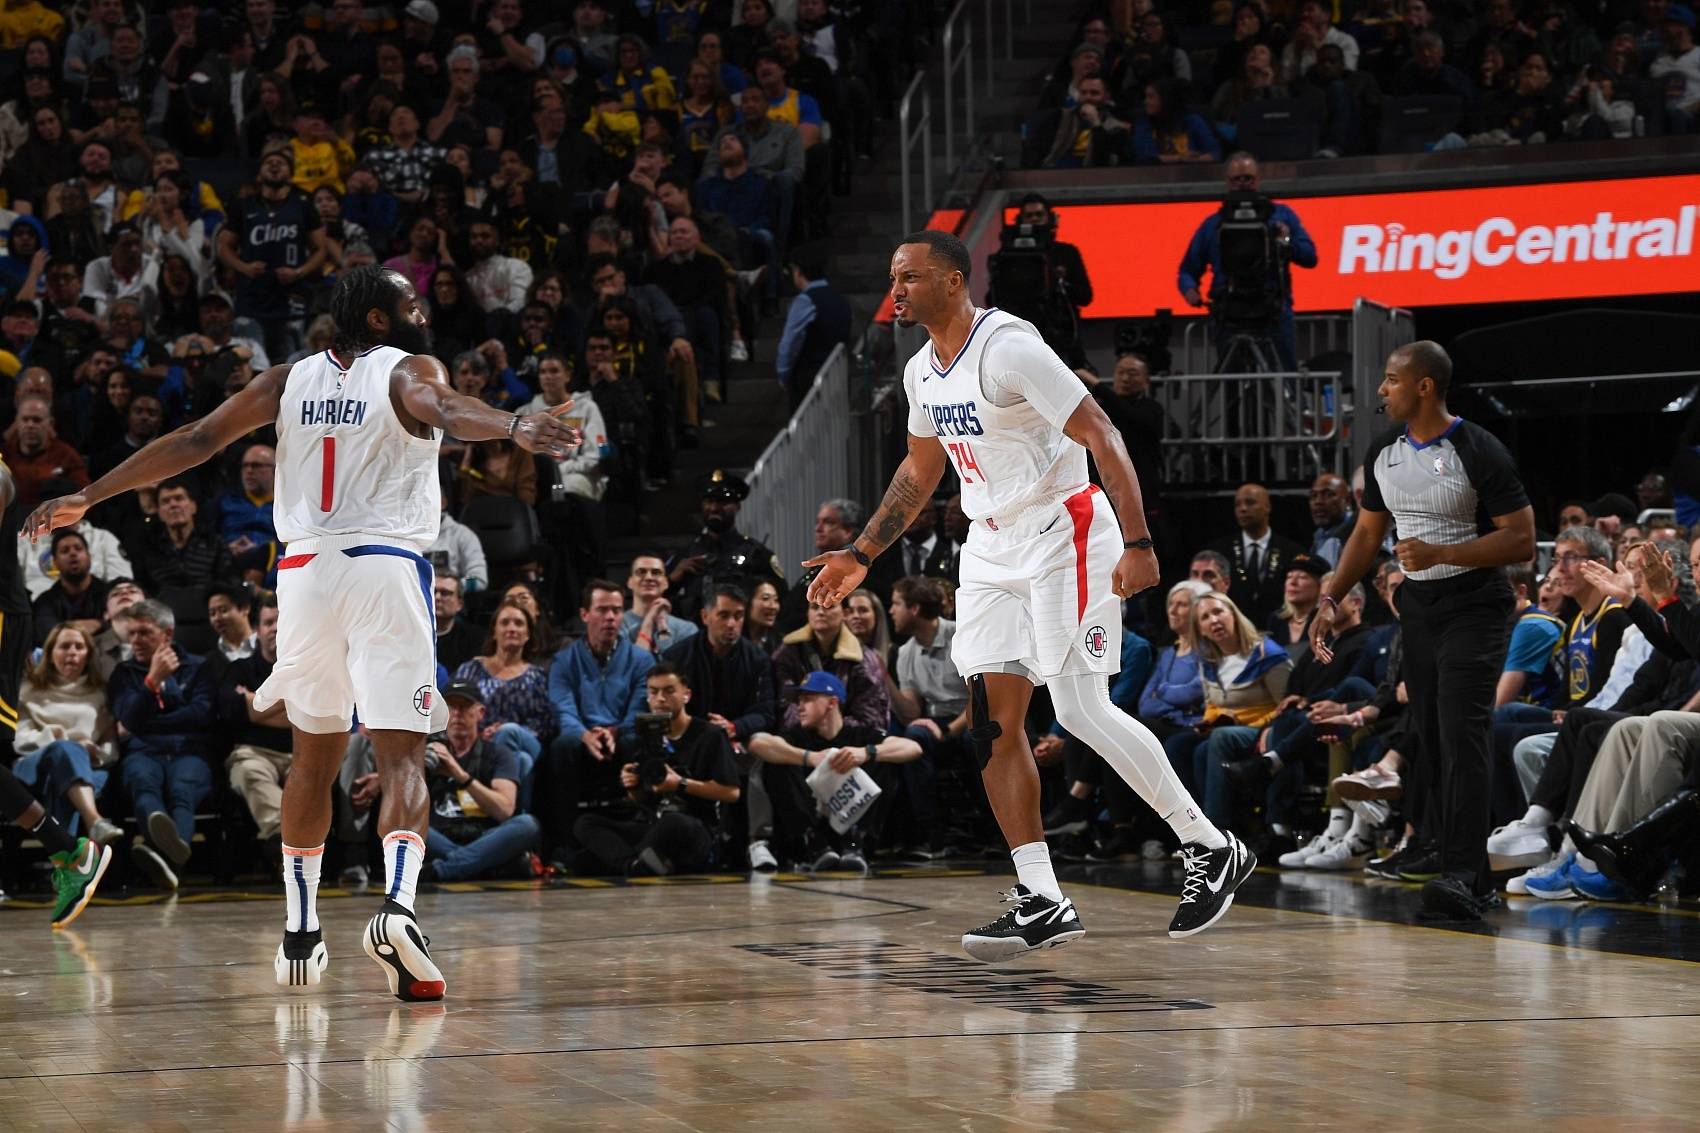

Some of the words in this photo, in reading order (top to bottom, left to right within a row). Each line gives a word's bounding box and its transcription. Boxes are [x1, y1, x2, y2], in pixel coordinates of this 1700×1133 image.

[250, 223, 298, 246] Clips
[1338, 205, 1697, 279] RingCentral
[922, 401, 984, 436] LIPPERS
[321, 437, 335, 512] 1
